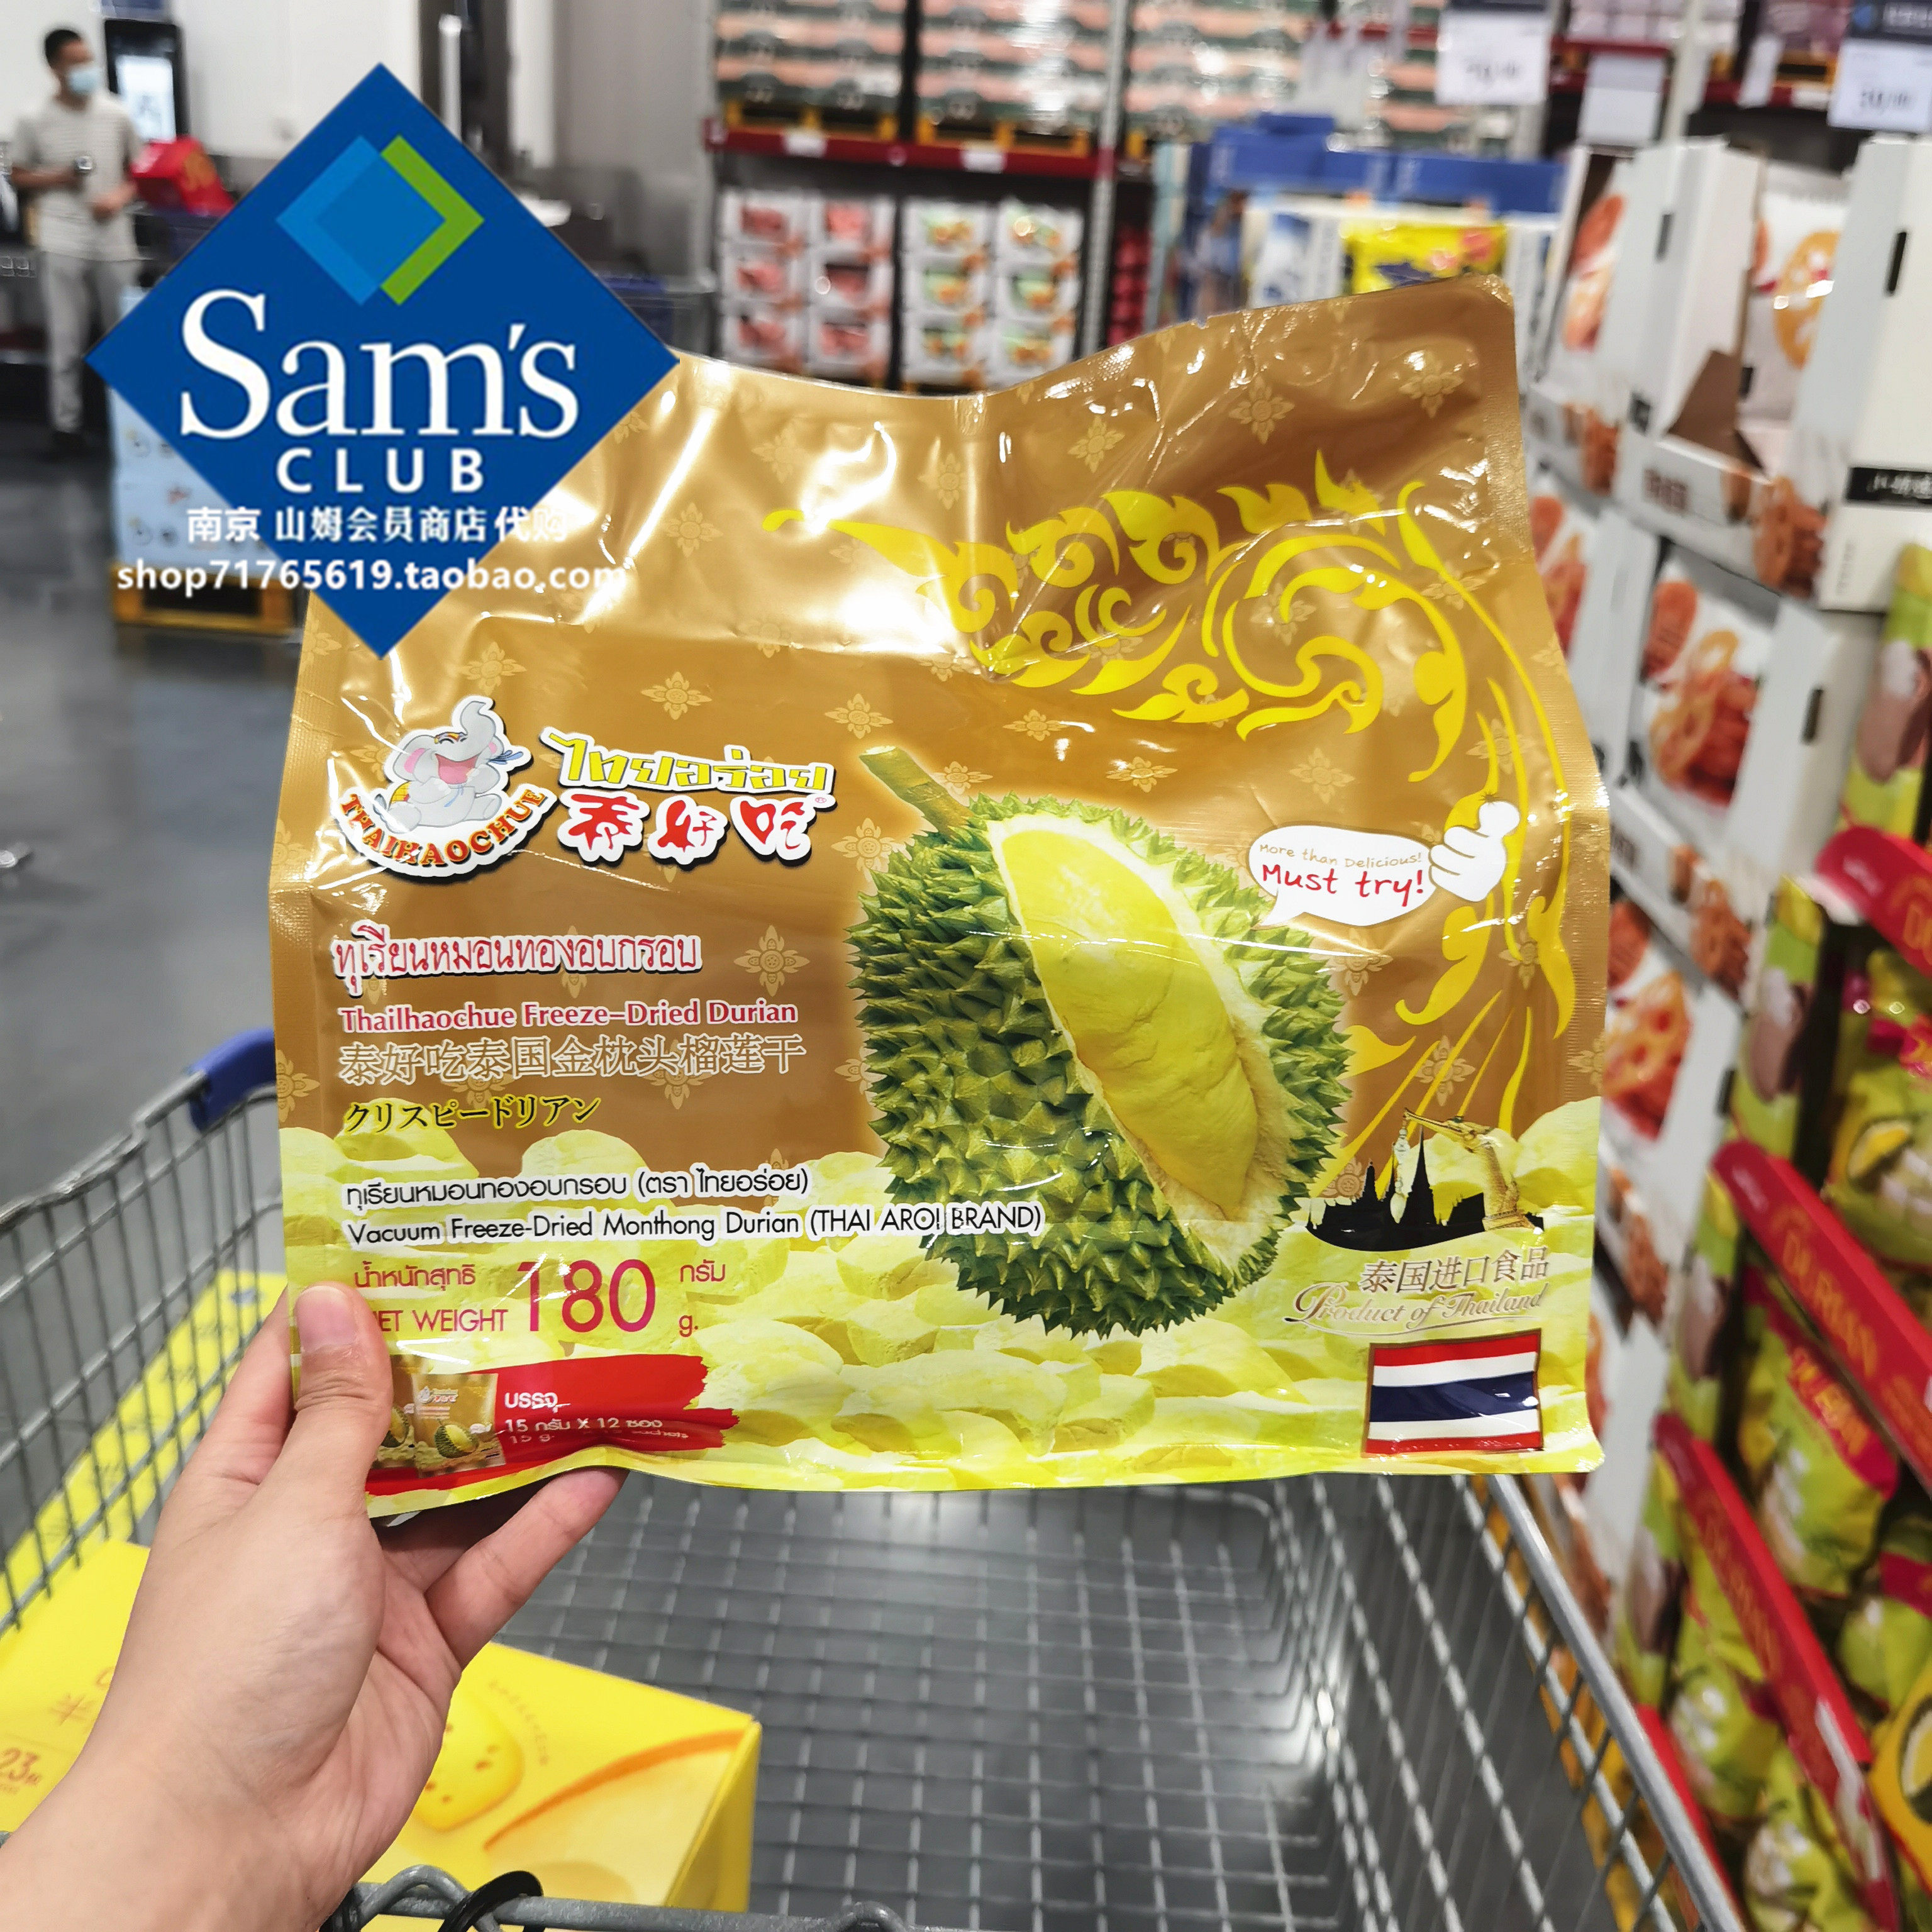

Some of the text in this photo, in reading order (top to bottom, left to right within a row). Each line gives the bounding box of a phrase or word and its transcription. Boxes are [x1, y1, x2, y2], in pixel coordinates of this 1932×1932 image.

[549, 732, 830, 791] ไทยอร่อย
[340, 789, 547, 866] THAIHAOCHUE
[1260, 843, 1422, 868] More than Delicious!
[1262, 864, 1424, 908] Must try!
[335, 923, 697, 994] ทุเรียนหมอนทองอบกรอบ
[340, 1006, 515, 1032] Thailhaochue
[709, 999, 798, 1023] Durian
[340, 1035, 806, 1084] 泰好吃泰国金枕头榴莲干
[346, 1096, 601, 1133] クリスピードリアン
[638, 1171, 688, 1197] (ตรา
[347, 1223, 440, 1244] Vacuum
[452, 1211, 592, 1238] Freeze-Dried
[603, 1209, 715, 1241] Monthong
[727, 1211, 799, 1234] Durian
[810, 1208, 870, 1236] (THAI
[952, 1206, 1041, 1231] BRAND)
[1361, 1246, 1548, 1294] 泰国进口食品
[517, 1258, 656, 1333] 180
[679, 1259, 726, 1284] กรัม
[1293, 1281, 1550, 1330] Product of Thailand
[373, 1309, 699, 1337] ET WEIGHT g.
[504, 1418, 528, 1433] 15
[597, 1417, 620, 1428] 12
